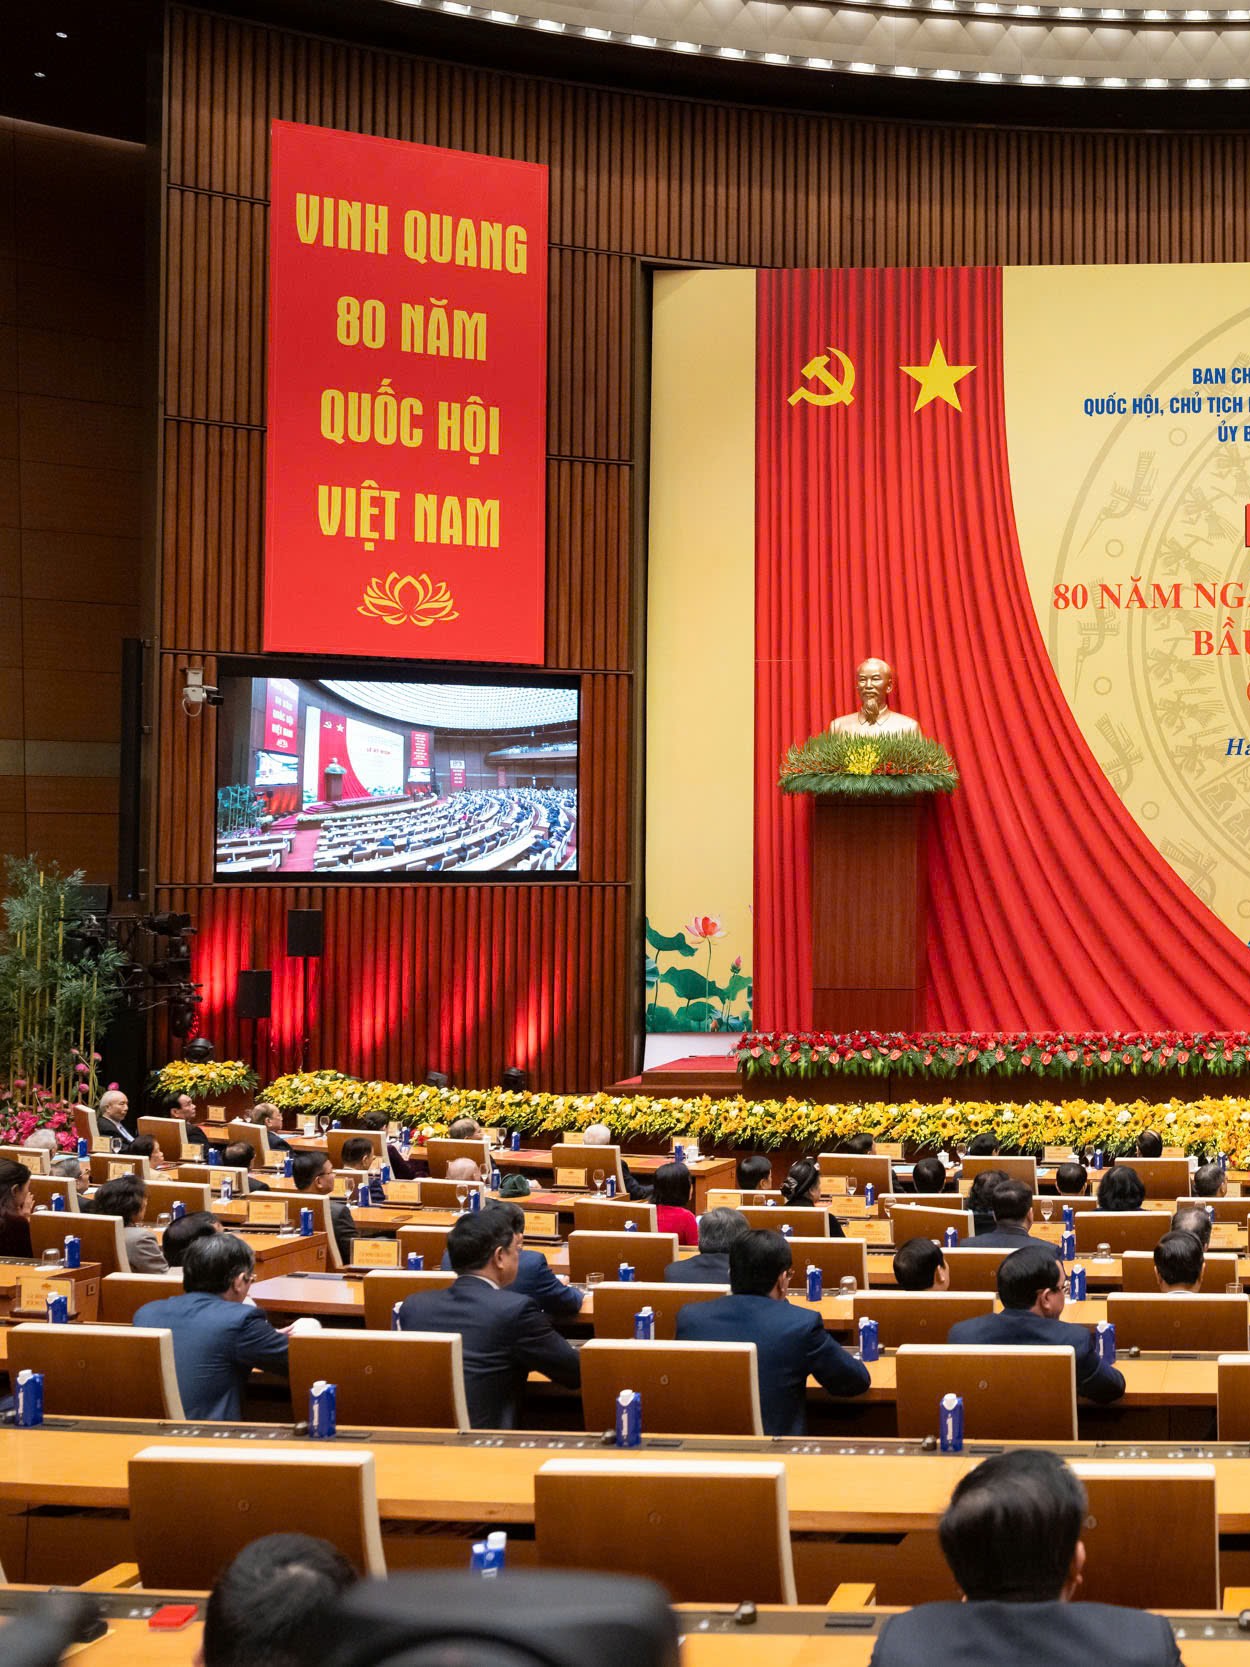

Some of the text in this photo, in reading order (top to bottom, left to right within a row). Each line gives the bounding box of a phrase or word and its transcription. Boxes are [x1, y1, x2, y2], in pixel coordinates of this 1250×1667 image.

[296, 193, 527, 274] VINH QUANG
[337, 296, 486, 360] 80 NĂM
[1193, 368, 1225, 384] BAN
[321, 379, 499, 465] QUỐC HỘI
[1084, 392, 1126, 416] QUỐC
[1133, 394, 1163, 417] HỘI,
[1170, 391, 1201, 413] CHỦ
[1207, 397, 1242, 416] TỊCH
[1218, 420, 1238, 442] ỦY
[318, 480, 499, 551] VIỆT NAM
[1053, 584, 1088, 610] 80
[1098, 577, 1181, 609] NĂM
